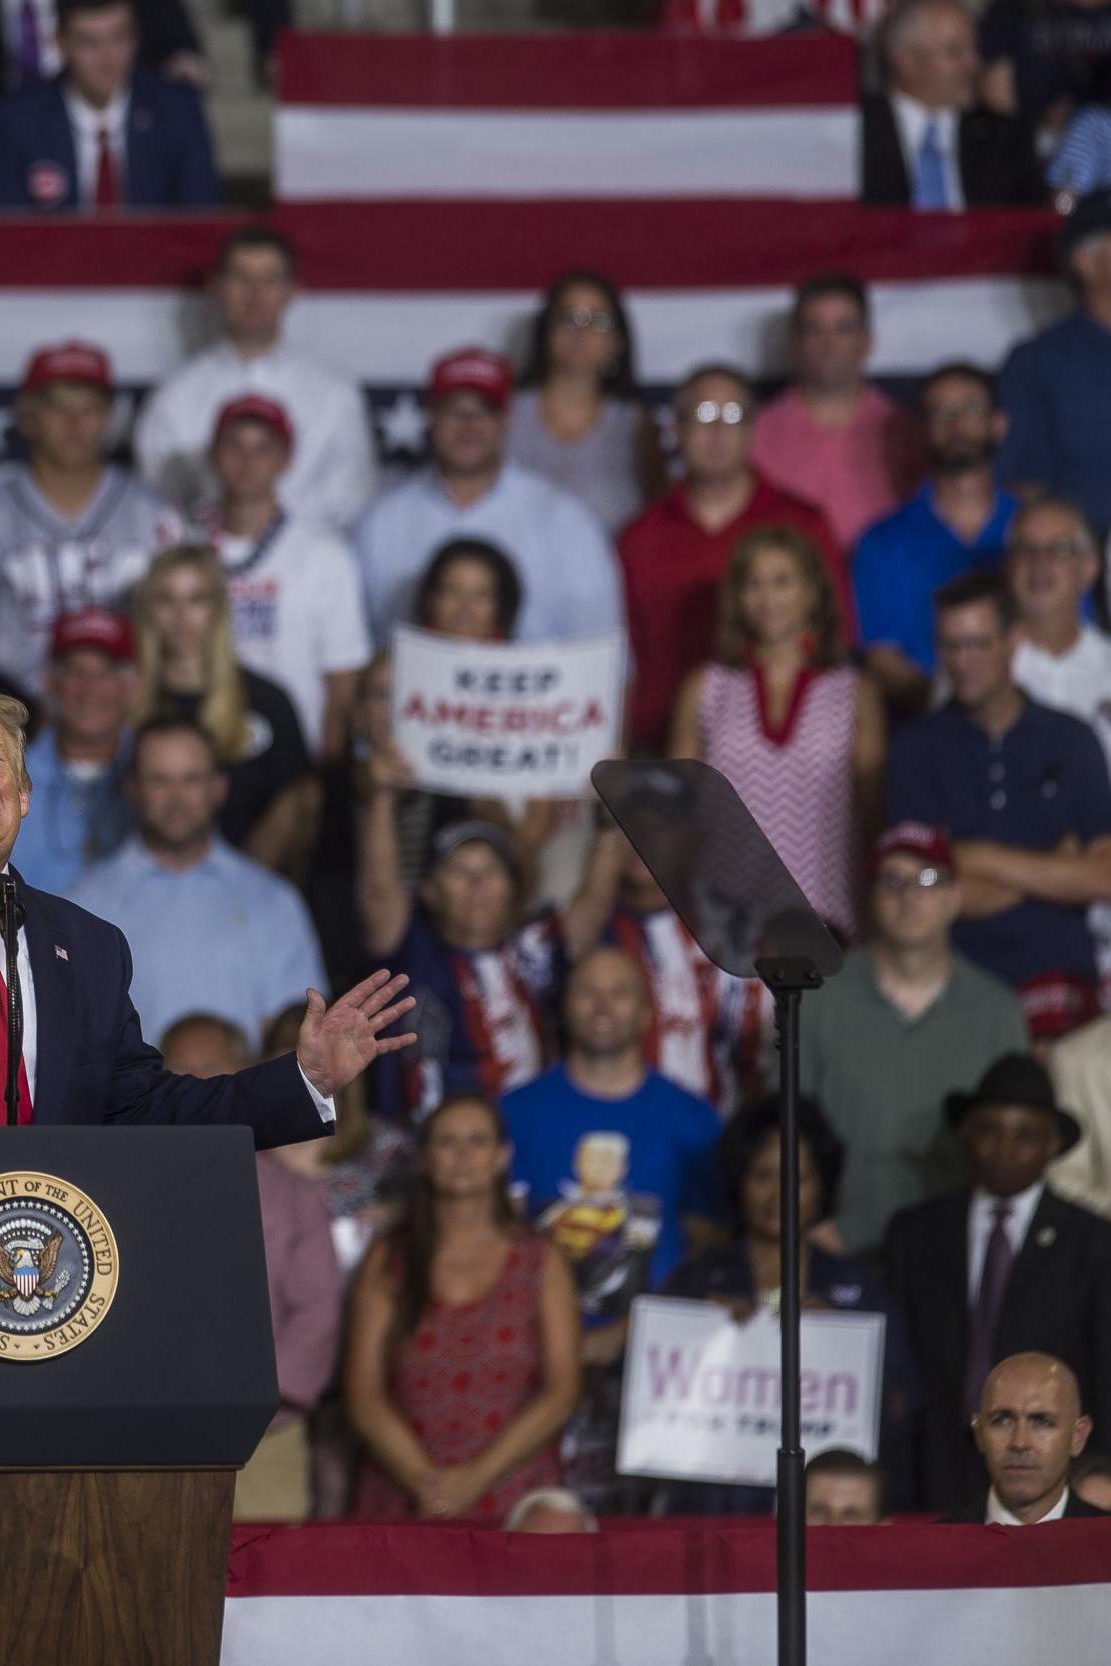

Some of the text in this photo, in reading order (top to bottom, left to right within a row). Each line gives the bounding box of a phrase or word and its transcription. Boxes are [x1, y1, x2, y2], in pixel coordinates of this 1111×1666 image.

[454, 664, 561, 693] KEEP
[403, 692, 604, 737] AMERICA
[426, 737, 582, 774] GREAT!
[24, 1181, 42, 1192] OF
[45, 1184, 69, 1201] THE
[72, 1200, 113, 1276] UNITED
[43, 1293, 106, 1351] STATES
